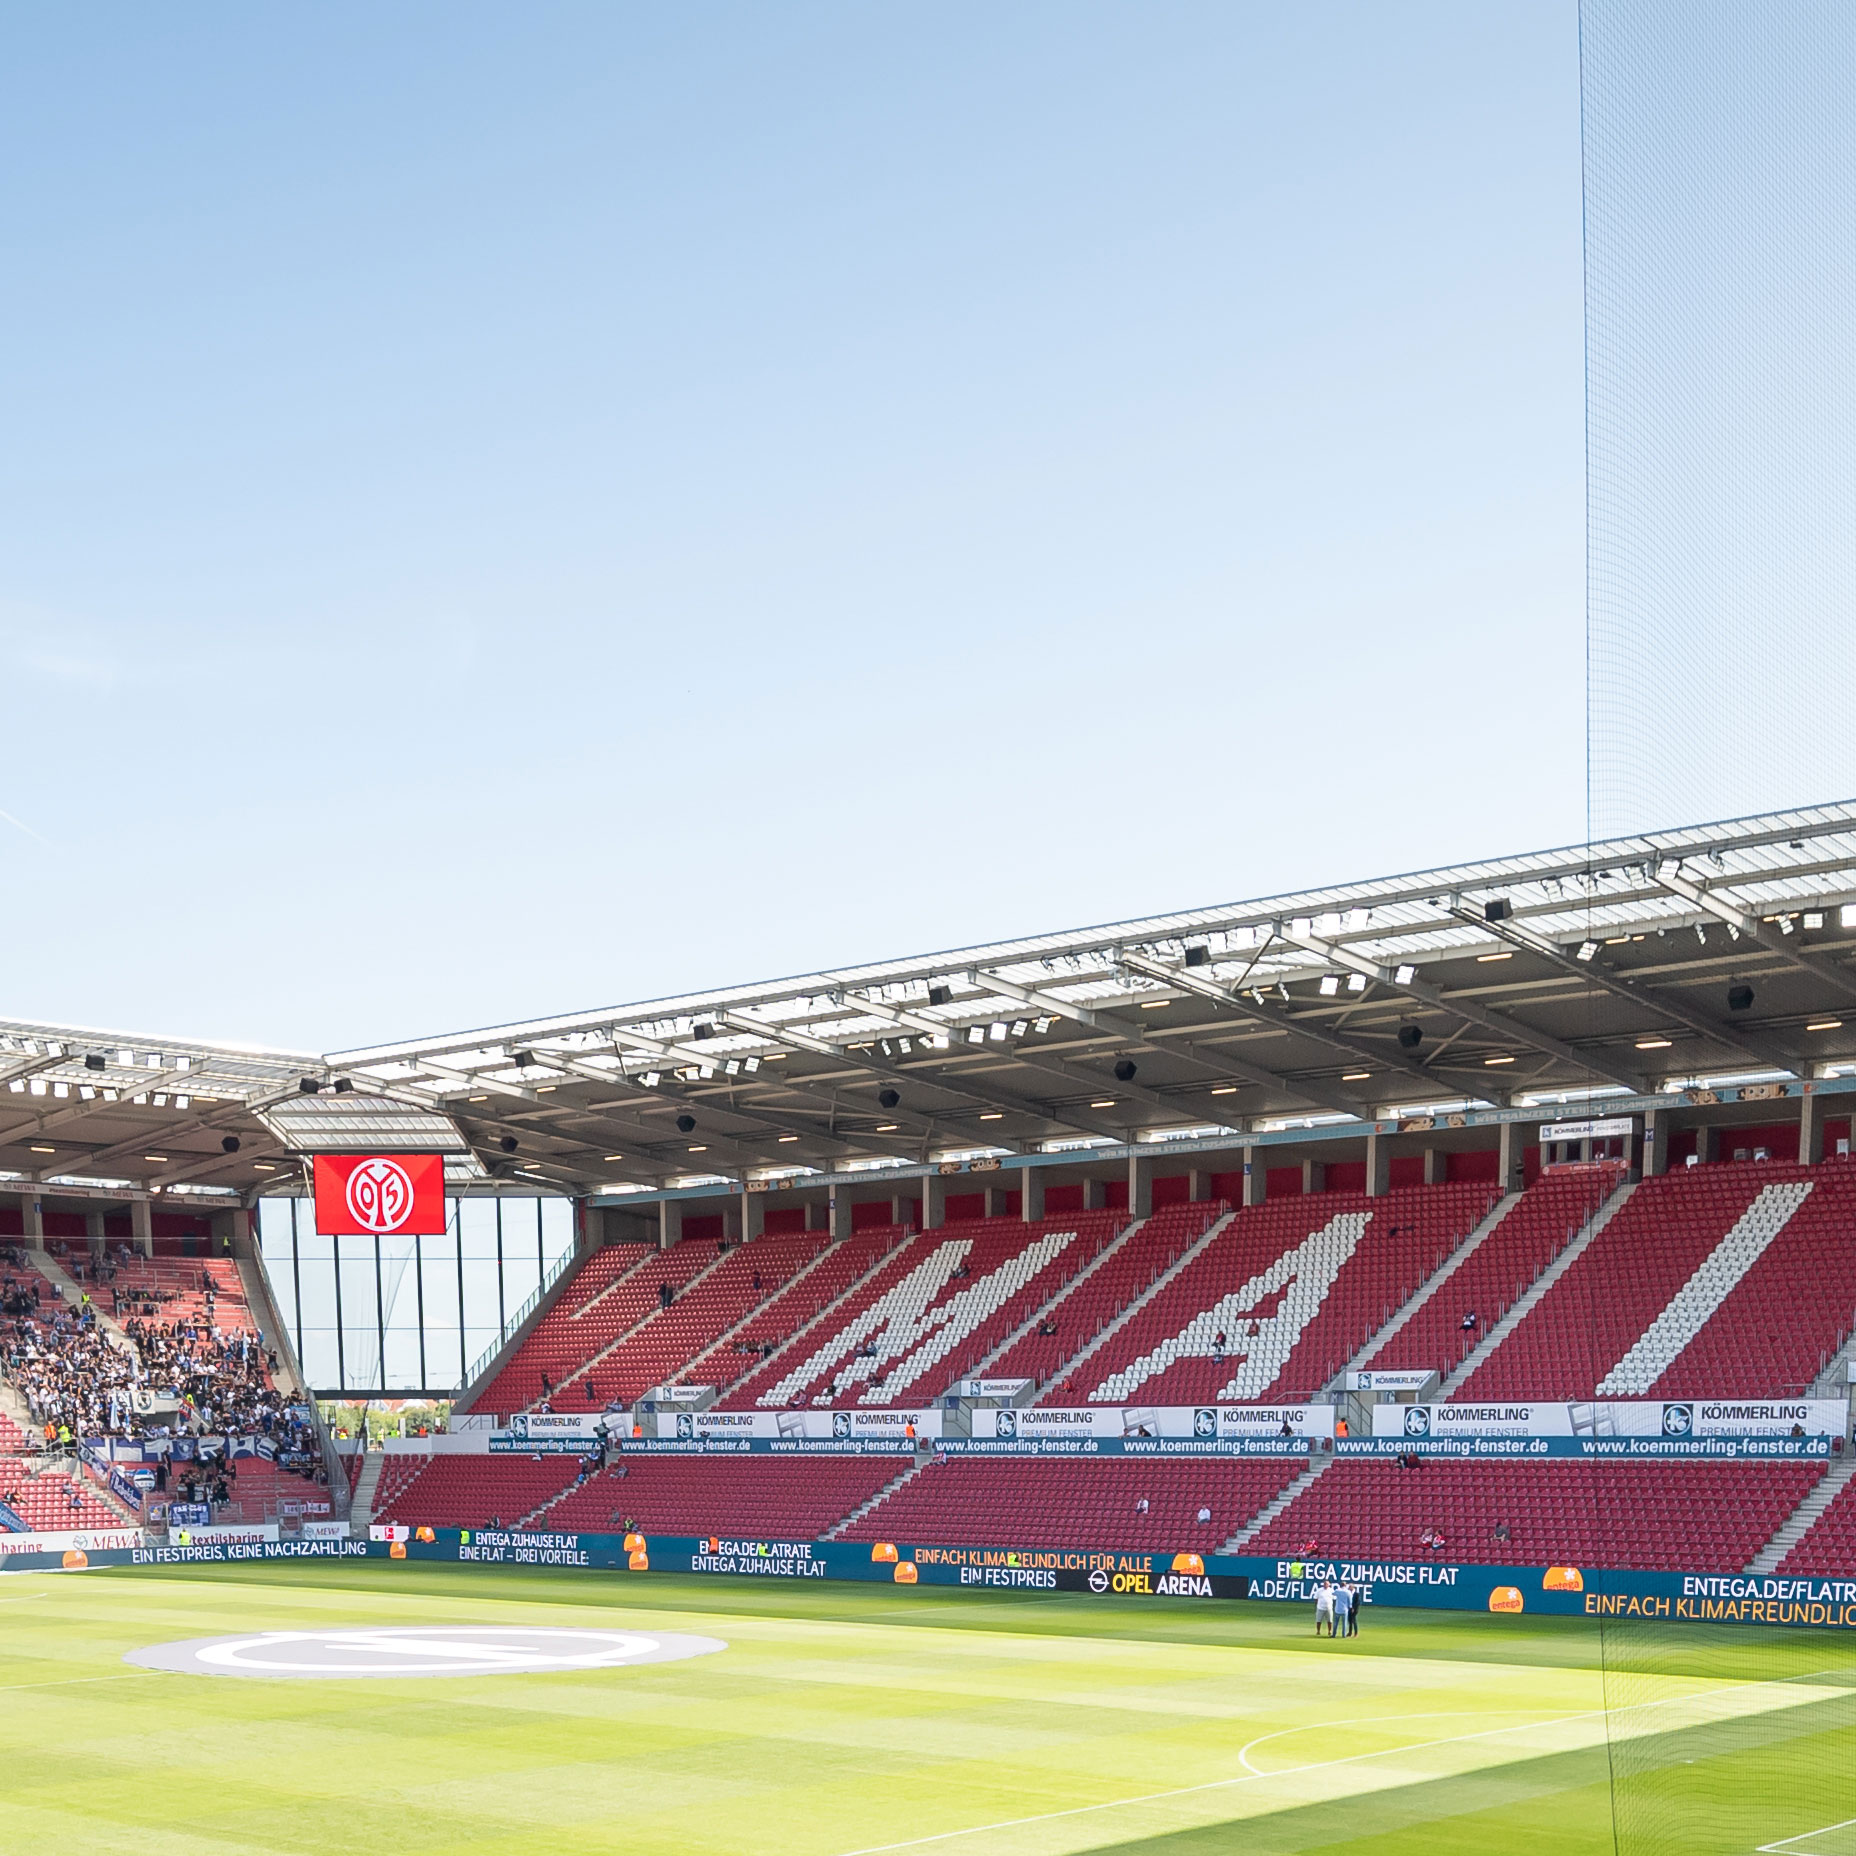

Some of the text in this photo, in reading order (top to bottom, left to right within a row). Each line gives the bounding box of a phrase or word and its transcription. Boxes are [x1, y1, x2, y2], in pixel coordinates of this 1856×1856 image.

[1375, 1374, 1422, 1384] KÖMMERLING
[855, 1411, 918, 1424] KÖMMERLING
[1022, 1409, 1093, 1423] KÖMMERLING
[1223, 1407, 1304, 1422] KÖMMERLING
[1437, 1405, 1529, 1420] KÖMMERLING
[1701, 1403, 1807, 1419] KÖMMERLING
[531, 1413, 581, 1427] KÖMMERLING
[697, 1412, 753, 1426] KÖMMERLING
[1022, 1429, 1092, 1438] PREMIUM FENSTER
[1223, 1428, 1264, 1437] PREMIUM
[1437, 1427, 1529, 1437] PREMIUM FENSTER
[1700, 1426, 1752, 1437] PREMIUM
[622, 1439, 751, 1453] www.koemmerling-fenster.de
[770, 1439, 914, 1453] www.koemmerling-fenster.de
[936, 1440, 1098, 1453] www.koemmerling-fenster.de
[1124, 1440, 1308, 1454] www.koemmerling-fenster.de
[1336, 1438, 1548, 1455] www.koemmerling-fenster.de
[1582, 1439, 1827, 1456] www.koemmerling-fenster.de
[92, 1534, 138, 1550] MEWA
[476, 1532, 578, 1549] ENTEGA ZUHAUSE FLAT
[132, 1541, 367, 1563] EIN FESTPREIS, KEINE NACHZAHLUNG
[459, 1545, 589, 1566] EINE FLAT DREI VORTEILE:
[691, 1555, 826, 1577] ENTEGA ZUHAUSE FLAT
[915, 1549, 1152, 1573] EINFACH FÜR ALLE
[961, 1567, 1057, 1587] EIN FESTPREIS
[1340, 1563, 1459, 1585] ZUHAUSE FLAT
[1112, 1573, 1213, 1597] OPEL ARENA
[1492, 1599, 1521, 1611] entega
[1585, 1594, 1670, 1617] EINFACH
